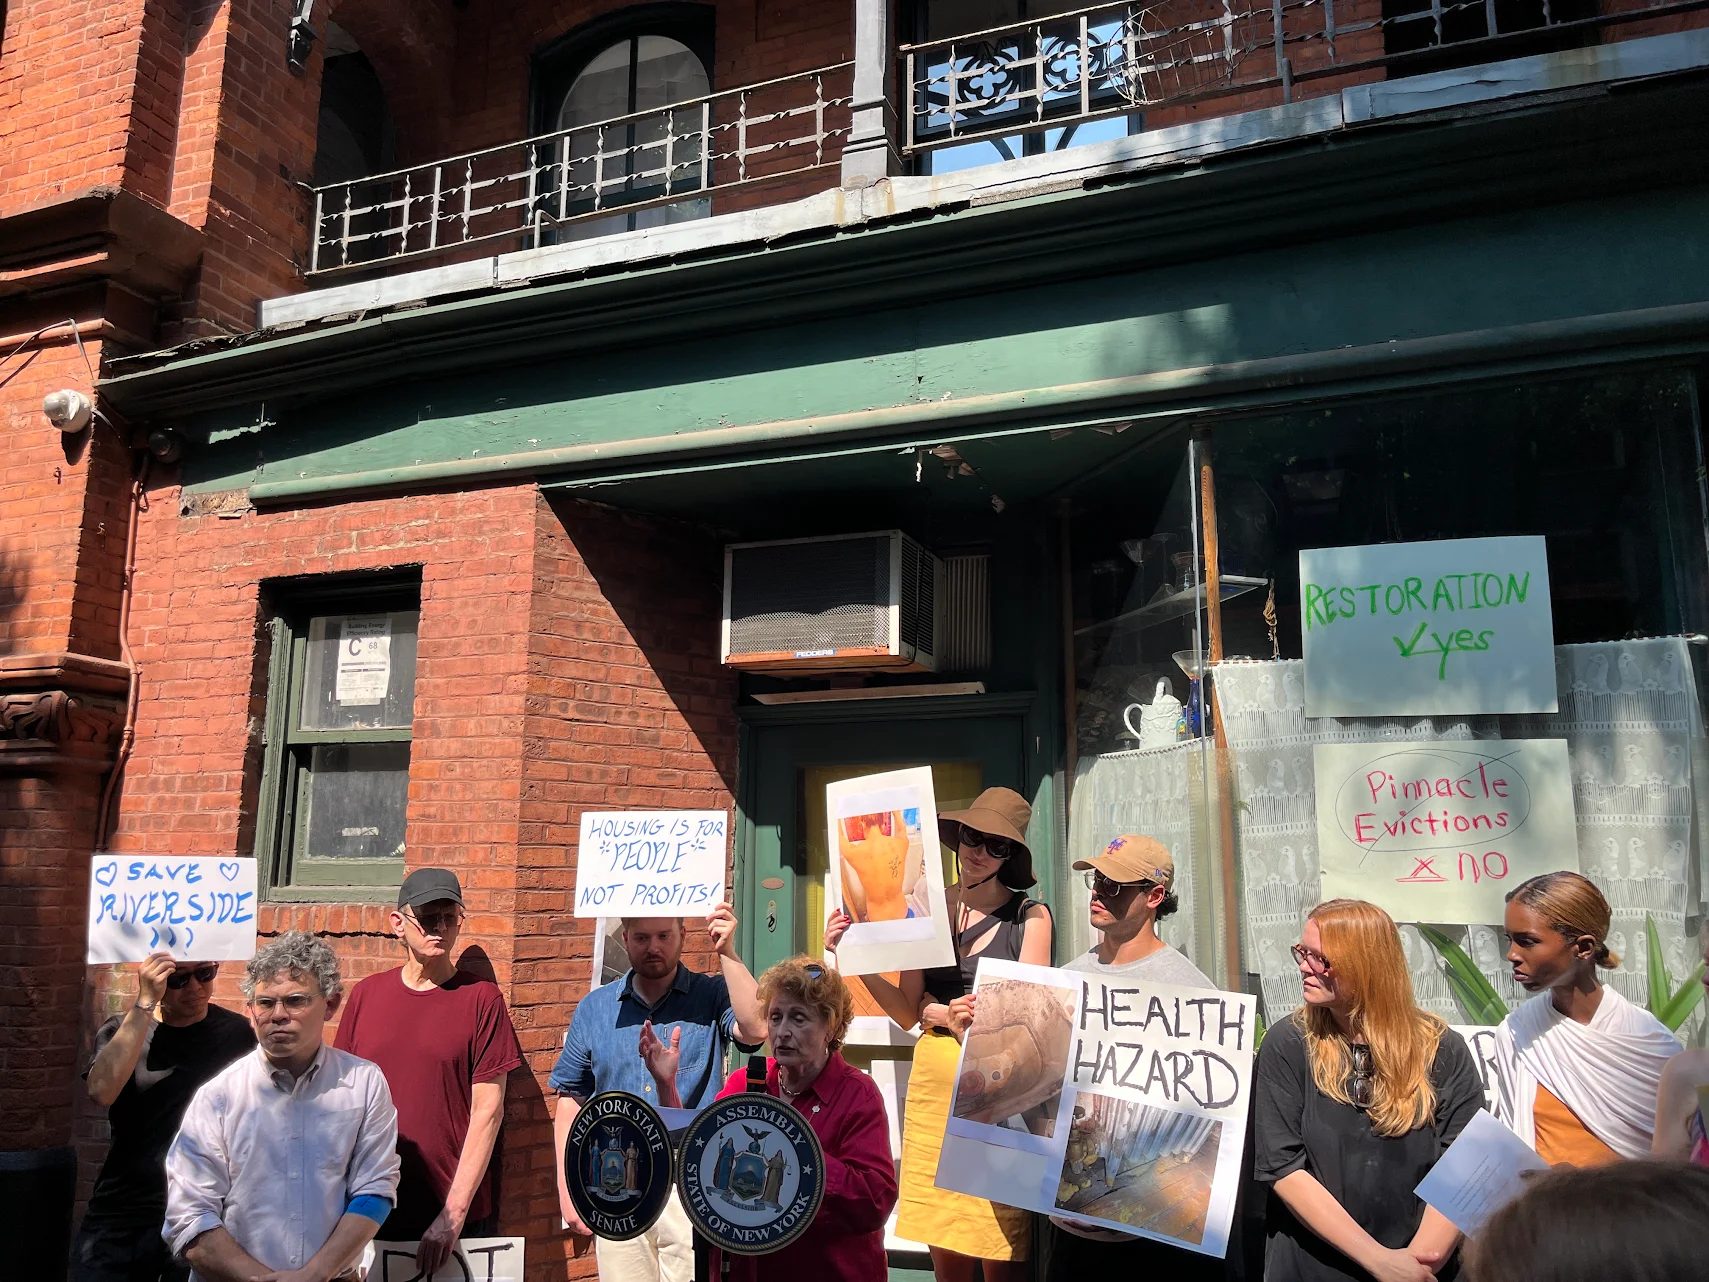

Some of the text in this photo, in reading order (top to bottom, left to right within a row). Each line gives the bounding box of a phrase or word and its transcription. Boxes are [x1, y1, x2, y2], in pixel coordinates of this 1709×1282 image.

[1305, 571, 1530, 632] RESTORATION
[348, 637, 362, 657] C
[368, 641, 378, 650] 68
[1430, 628, 1495, 681] yes
[1366, 761, 1511, 804] Pinnacle
[588, 818, 724, 839] HOUSING IS FOR
[1354, 810, 1509, 843] Evictions
[126, 861, 203, 884] SAVE
[96, 889, 254, 925] RIVERSIDE
[579, 882, 721, 908] NOT PROFITS!
[1080, 980, 1246, 1050] HEALTH
[1073, 1039, 1240, 1109] HAZARD
[572, 1099, 664, 1154] NEW YORK STATE
[714, 1105, 807, 1147] ASSEMBLY
[589, 1209, 638, 1233] SENATE
[686, 1162, 811, 1242] STATE OF NEW YORK
